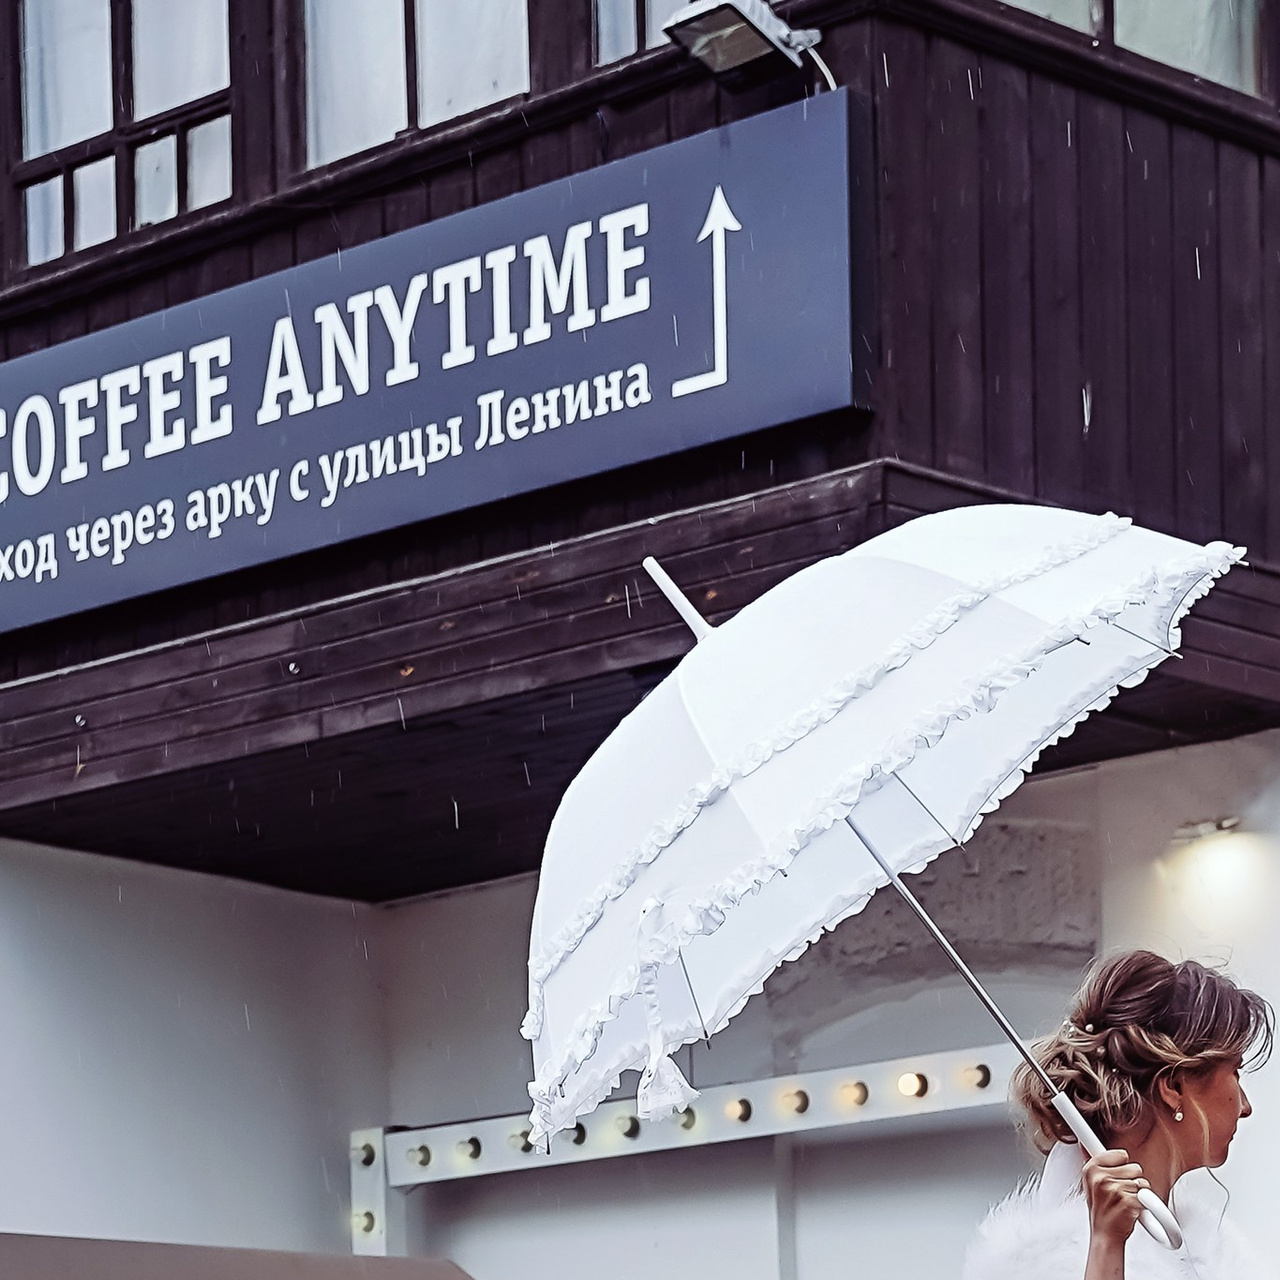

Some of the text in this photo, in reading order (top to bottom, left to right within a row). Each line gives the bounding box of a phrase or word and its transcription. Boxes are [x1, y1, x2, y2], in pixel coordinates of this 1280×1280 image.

[0, 203, 650, 504] OFFEE ANYTIME
[66, 498, 175, 566] через
[185, 468, 280, 539] арку
[289, 459, 309, 502] с
[318, 416, 463, 508] улицы
[474, 362, 652, 451] Ленина
